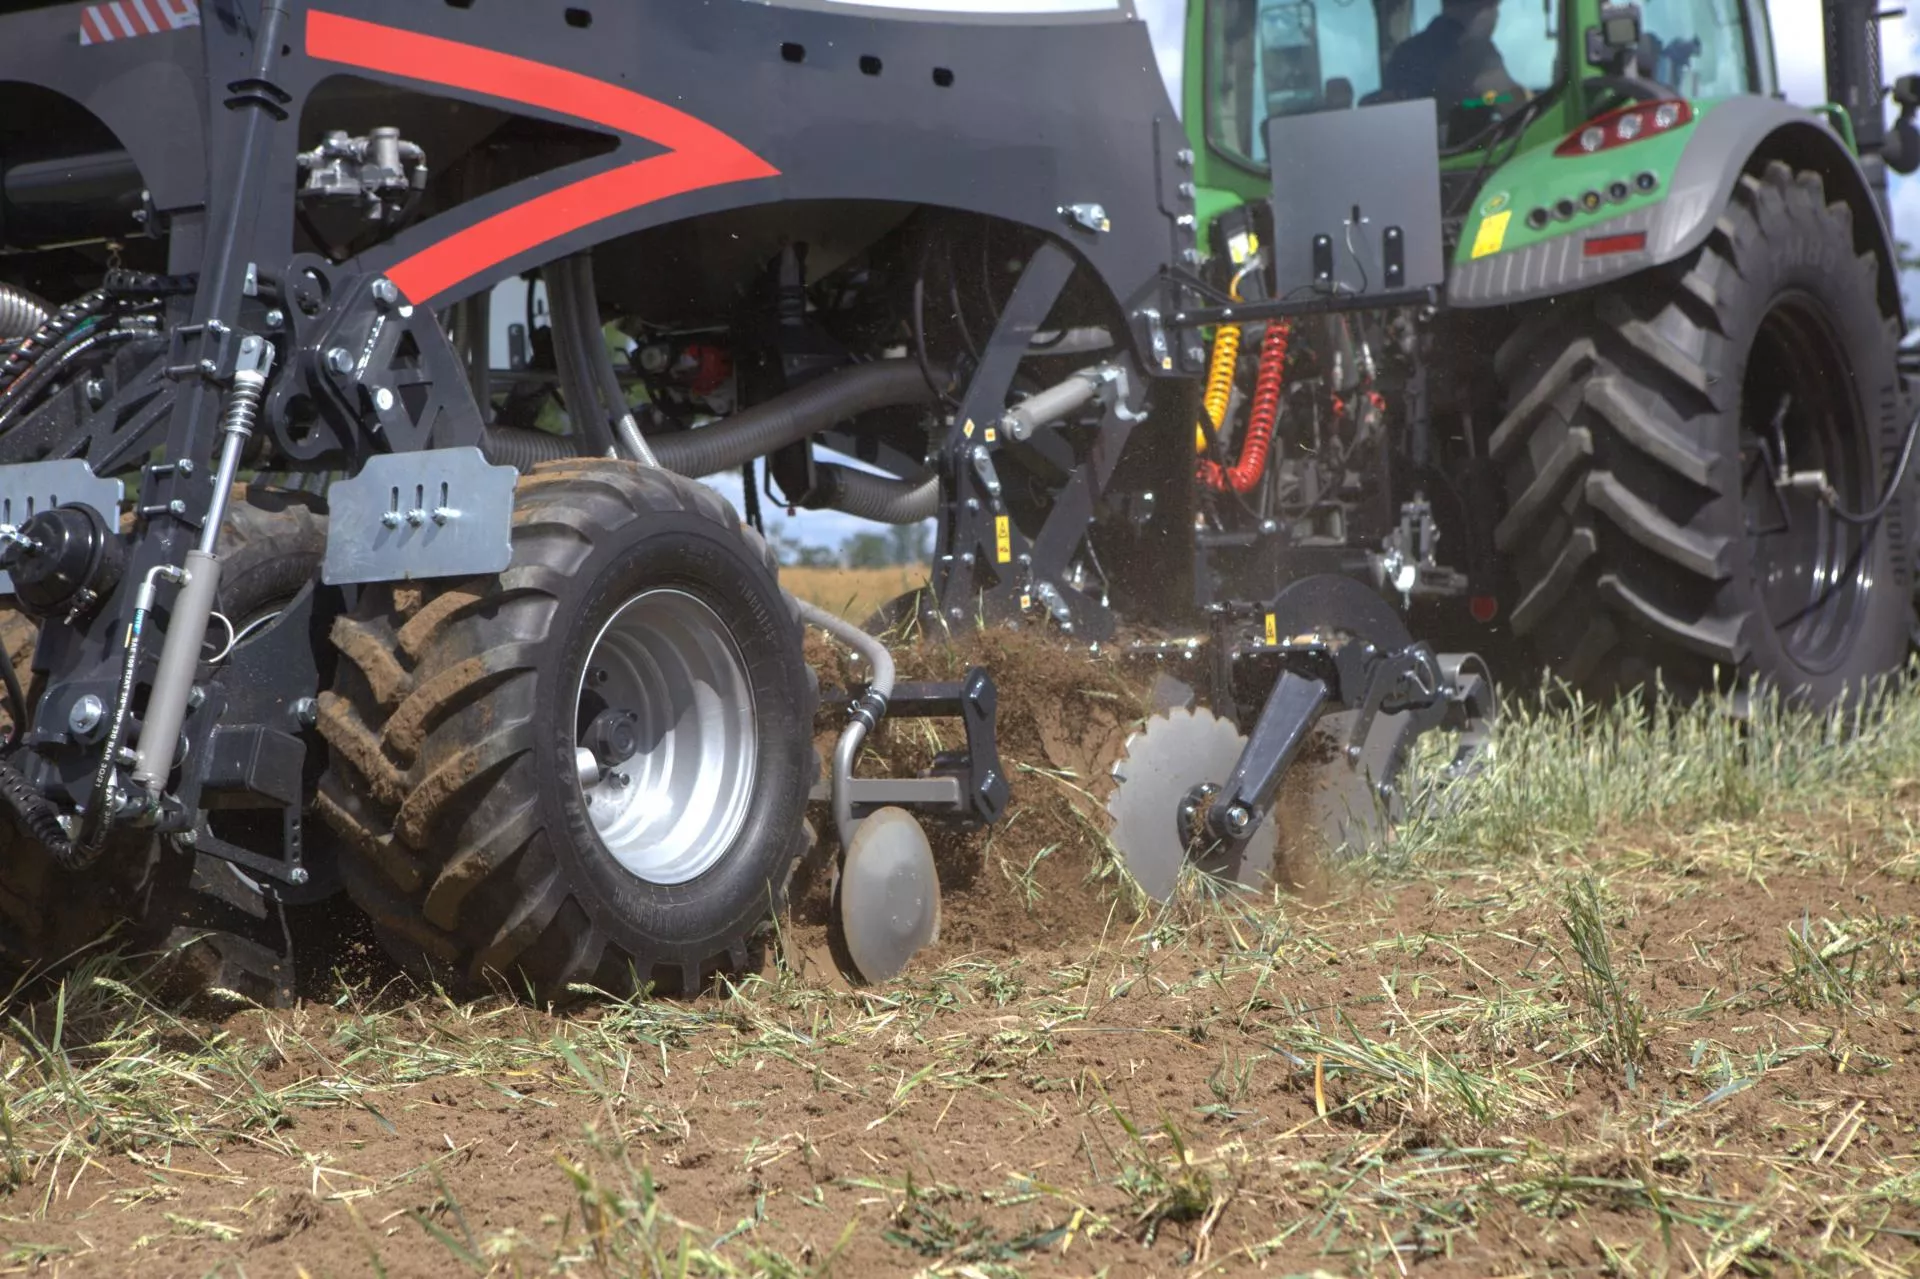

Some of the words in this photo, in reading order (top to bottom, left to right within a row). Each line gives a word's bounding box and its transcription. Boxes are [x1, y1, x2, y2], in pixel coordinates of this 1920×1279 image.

[1880, 384, 1907, 586] TRELLBORG
[123, 669, 133, 690] R2AT
[104, 740, 115, 761] BAR
